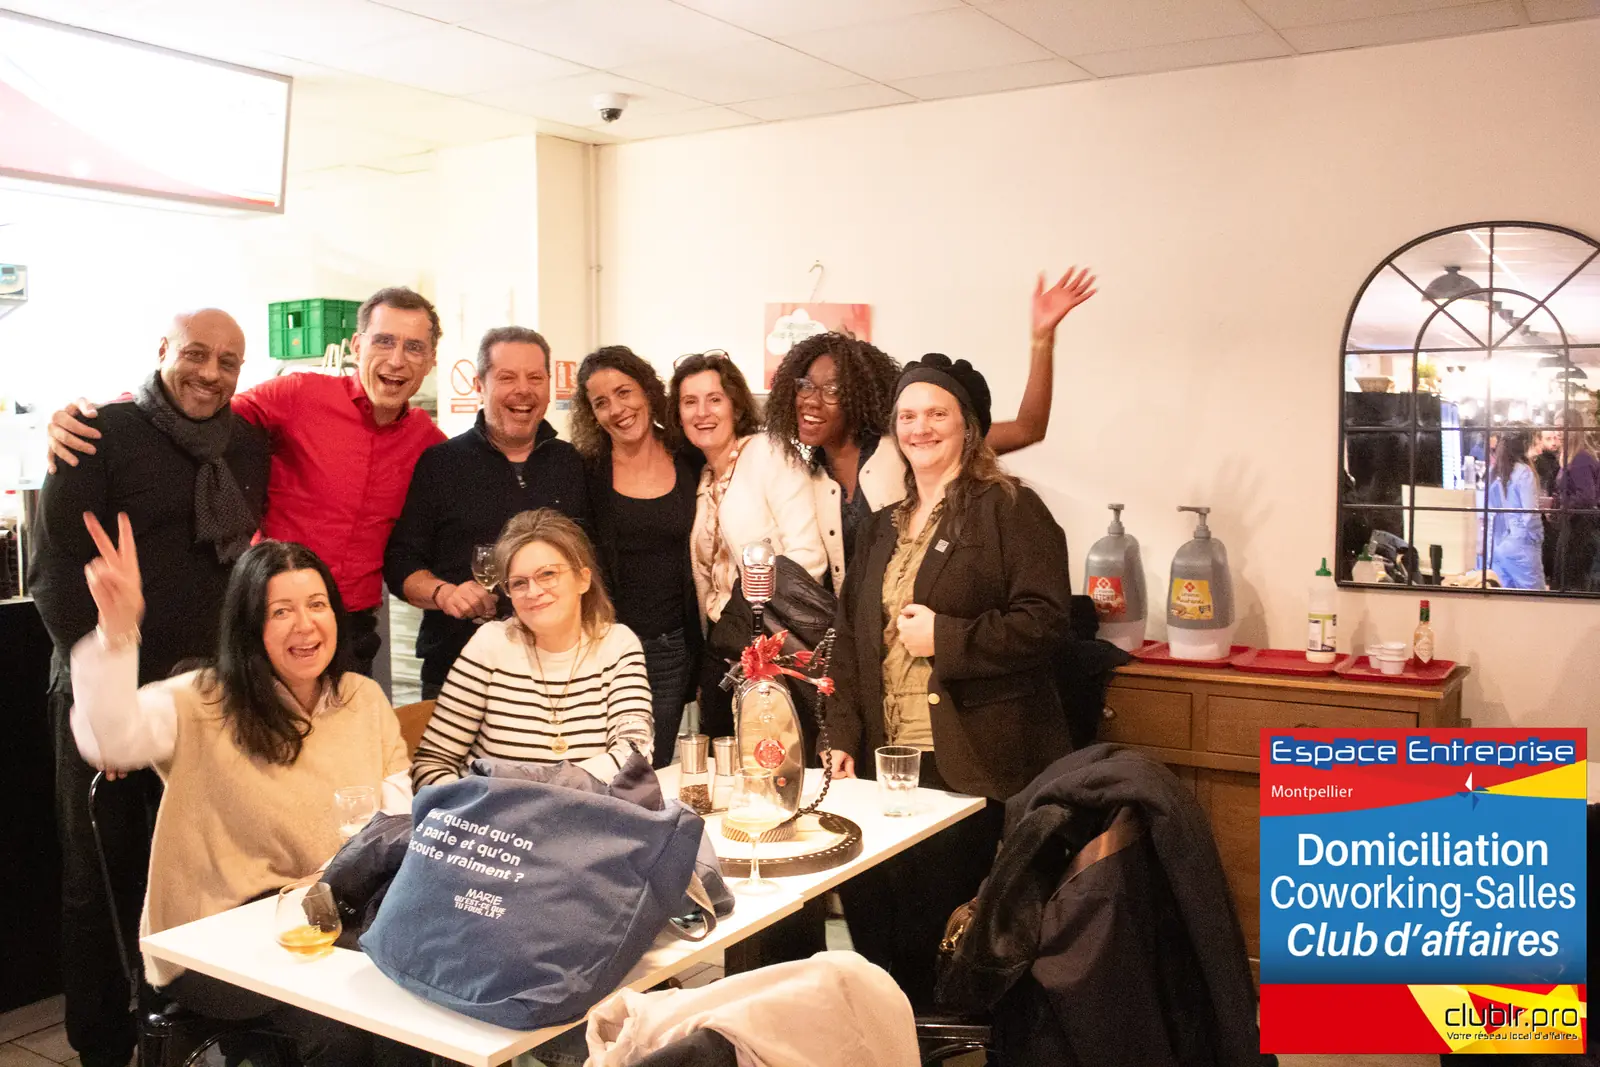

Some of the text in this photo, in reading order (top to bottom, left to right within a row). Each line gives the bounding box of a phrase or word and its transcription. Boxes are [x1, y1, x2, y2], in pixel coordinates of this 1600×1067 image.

[444, 814, 490, 836] quand
[490, 829, 533, 851] qu'on
[423, 826, 457, 845] parle
[460, 839, 476, 850] et
[477, 844, 521, 866] qu'on
[446, 854, 511, 880] vraiment
[514, 872, 525, 883] ?
[454, 895, 507, 915] QU'EST-CE QUE
[455, 901, 464, 909] TU
[465, 888, 503, 905] MARIE
